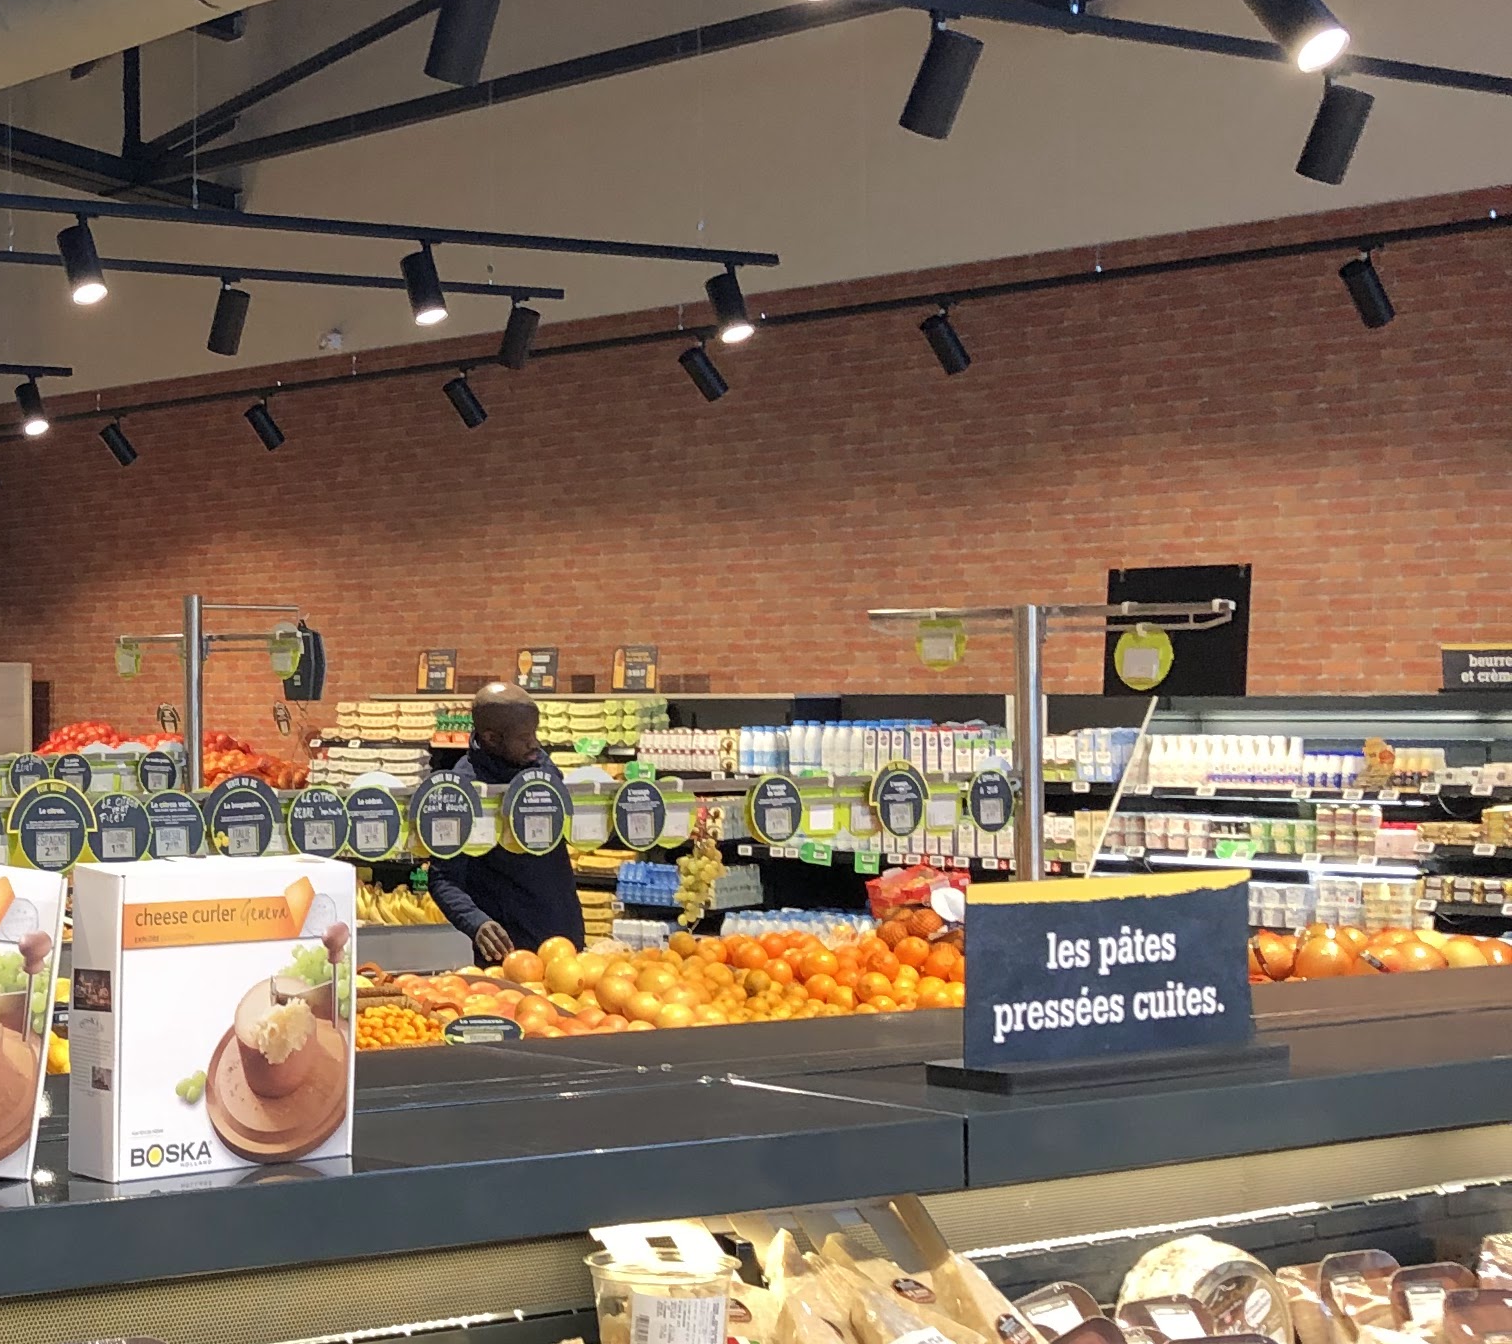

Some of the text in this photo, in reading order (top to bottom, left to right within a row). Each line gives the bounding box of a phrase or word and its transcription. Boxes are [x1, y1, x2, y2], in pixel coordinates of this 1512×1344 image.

[1461, 669, 1474, 683] et
[135, 898, 288, 927] cheese curler Geneva
[1046, 925, 1176, 975] les pâtes
[993, 983, 1225, 1044] pressées cuites.
[130, 1140, 212, 1168] BOSKA
